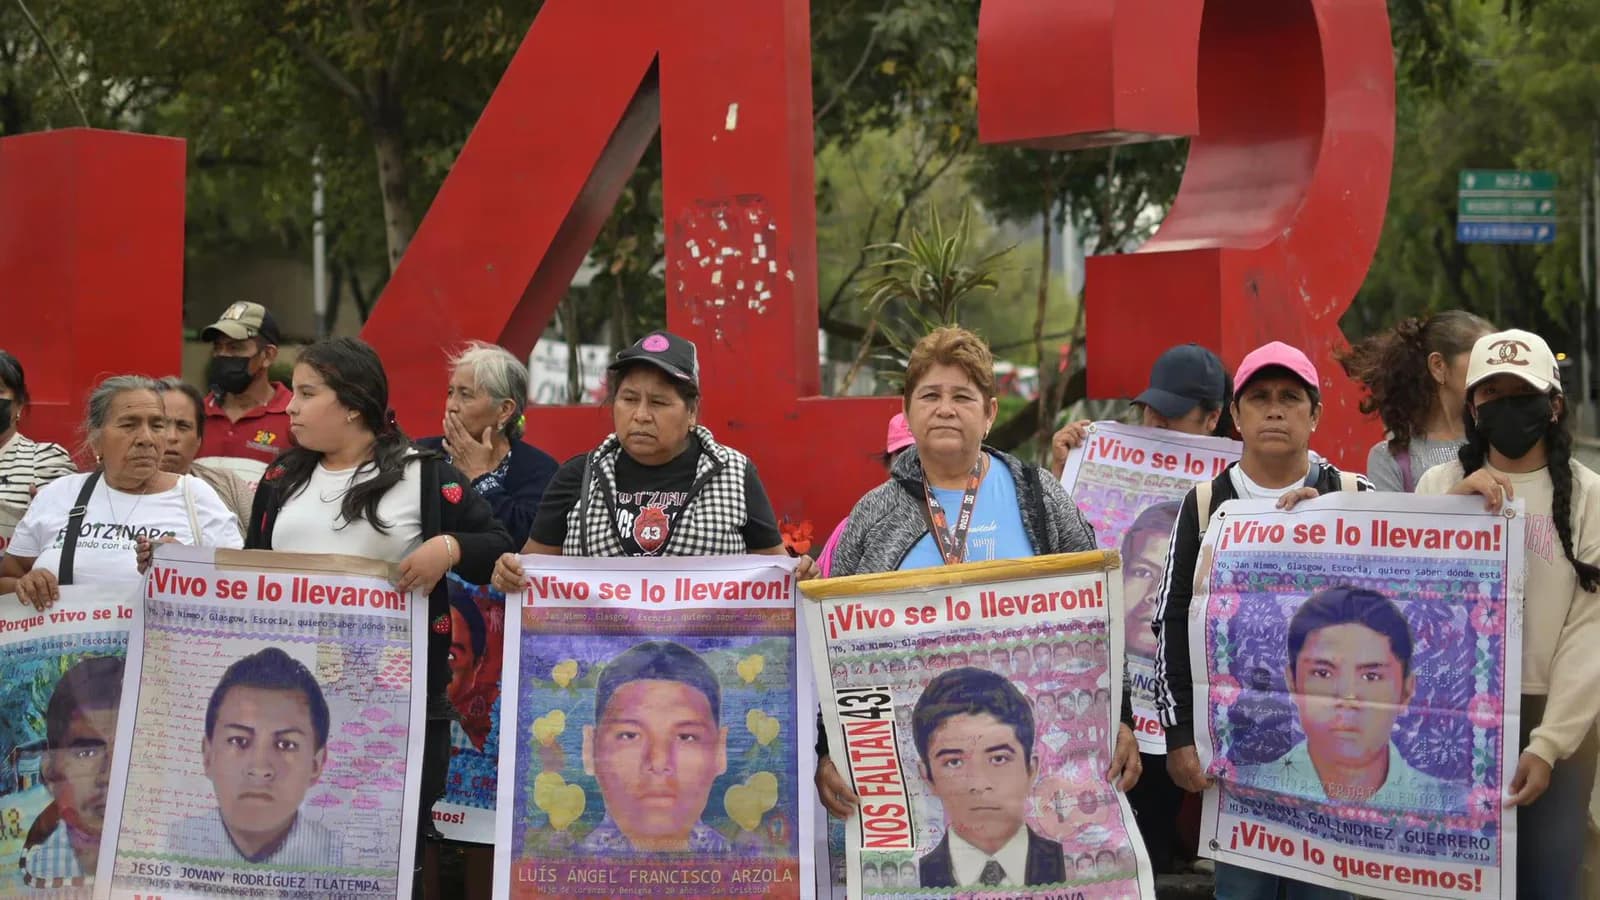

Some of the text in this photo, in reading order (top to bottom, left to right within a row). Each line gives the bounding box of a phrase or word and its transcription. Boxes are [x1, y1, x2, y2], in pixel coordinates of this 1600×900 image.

[1087, 435, 1145, 465] ¡Vivo
[1151, 451, 1178, 470] se
[1184, 453, 1204, 475] lo
[641, 526, 661, 539] 43
[1220, 518, 1502, 551] ¡Vivo se lo llevaron!
[1217, 561, 1501, 579] Yo, Jan Nimmo, Glasgow, Escocia, quiero saber dónde está
[149, 567, 406, 611] ¡Vivo se lo llevaron!
[526, 575, 790, 606] ¡Vivo se lo llevaron!
[0, 614, 44, 634] Porque
[49, 610, 86, 626] vivo
[92, 608, 112, 620] se
[163, 608, 174, 617] Jan
[178, 610, 204, 621] Nimmo,
[209, 612, 248, 624] Glasgow,
[253, 615, 292, 626] Escocia,
[297, 618, 328, 629] quiero
[330, 619, 357, 629] saber
[362, 621, 386, 631] dónde
[595, 612, 632, 623] Glasgow,
[638, 613, 673, 624] Escocia,
[828, 581, 1104, 639] ¡Vivo se lo llevaron!
[852, 643, 866, 652] Jan
[869, 641, 897, 650] Nimmo,
[946, 631, 986, 643] Escocia,
[1133, 714, 1166, 737] ue
[836, 686, 909, 848] NOS FALTAN 43!
[1308, 812, 1394, 841] GALINDREZ
[1404, 829, 1490, 850] GUERRERO
[1230, 821, 1482, 892] ¡Vivo lo queremos!
[1452, 850, 1490, 862] Arcelia
[130, 862, 380, 893] JESÚS JOVANY RODRÍGUEZ TLATEMPA
[519, 865, 793, 884] LUÍS ÁNGEL FRANCISCO ARZOLA
